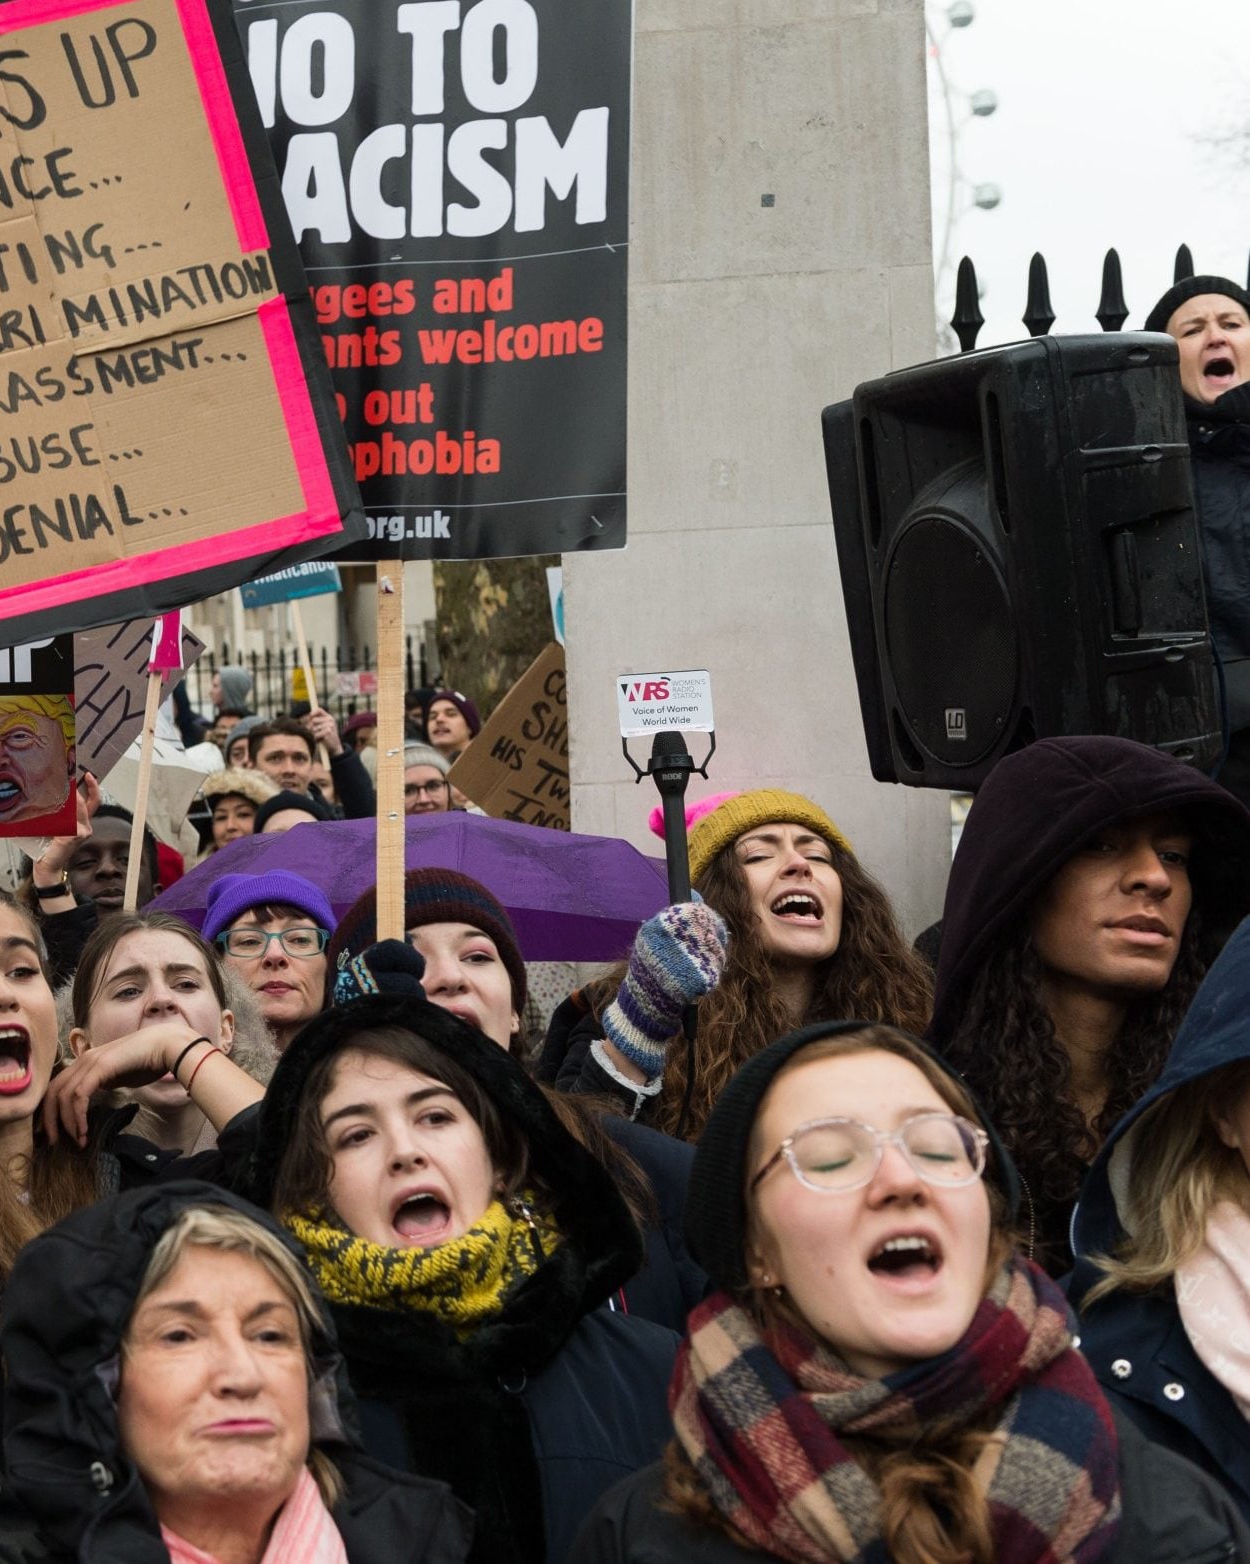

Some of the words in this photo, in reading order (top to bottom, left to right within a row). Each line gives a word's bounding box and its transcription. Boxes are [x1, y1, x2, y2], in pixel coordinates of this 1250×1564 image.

[61, 17, 157, 110] UP
[397, 0, 539, 116] TO
[281, 106, 610, 245] ACISM
[309, 278, 416, 325] gees
[432, 267, 514, 315] and
[418, 316, 605, 366] welcome
[363, 382, 435, 426] out
[347, 430, 501, 482] phobia
[621, 681, 670, 702] WRS
[632, 707, 655, 715] Voice
[656, 705, 665, 714] of
[666, 705, 699, 713] Women
[672, 692, 703, 700] STATION
[642, 717, 667, 726] World
[668, 716, 691, 724] Wide
[490, 735, 527, 771] HIS
